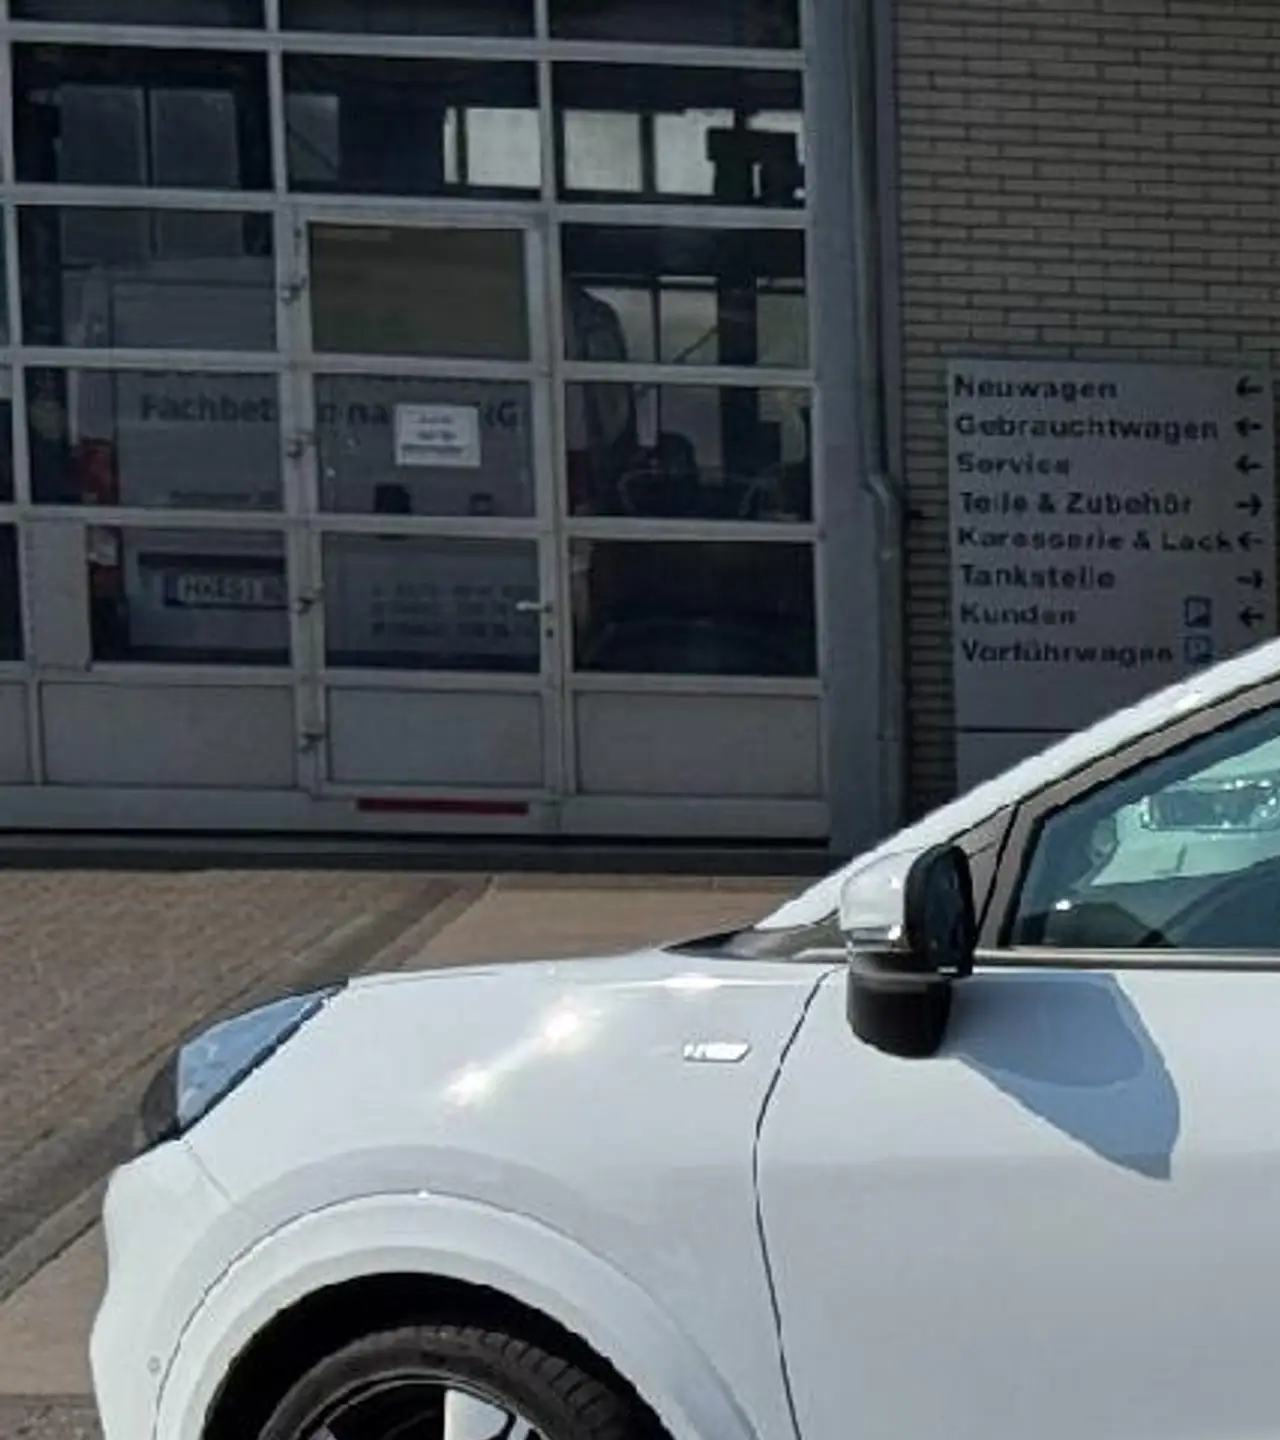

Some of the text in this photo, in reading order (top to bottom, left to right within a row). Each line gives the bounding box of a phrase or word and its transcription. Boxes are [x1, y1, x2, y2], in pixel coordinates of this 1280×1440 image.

[954, 373, 1118, 401] Neuwagen
[955, 415, 1219, 445] Gebrauchtwagen
[956, 452, 1071, 476] Service
[960, 491, 1193, 517] Teile & Zubehör
[1132, 529, 1151, 552] &
[1162, 529, 1235, 553] Lack
[960, 563, 1117, 590] Tankstelle
[960, 603, 1078, 626] Kunden
[961, 638, 1174, 669] Vorführwagen
